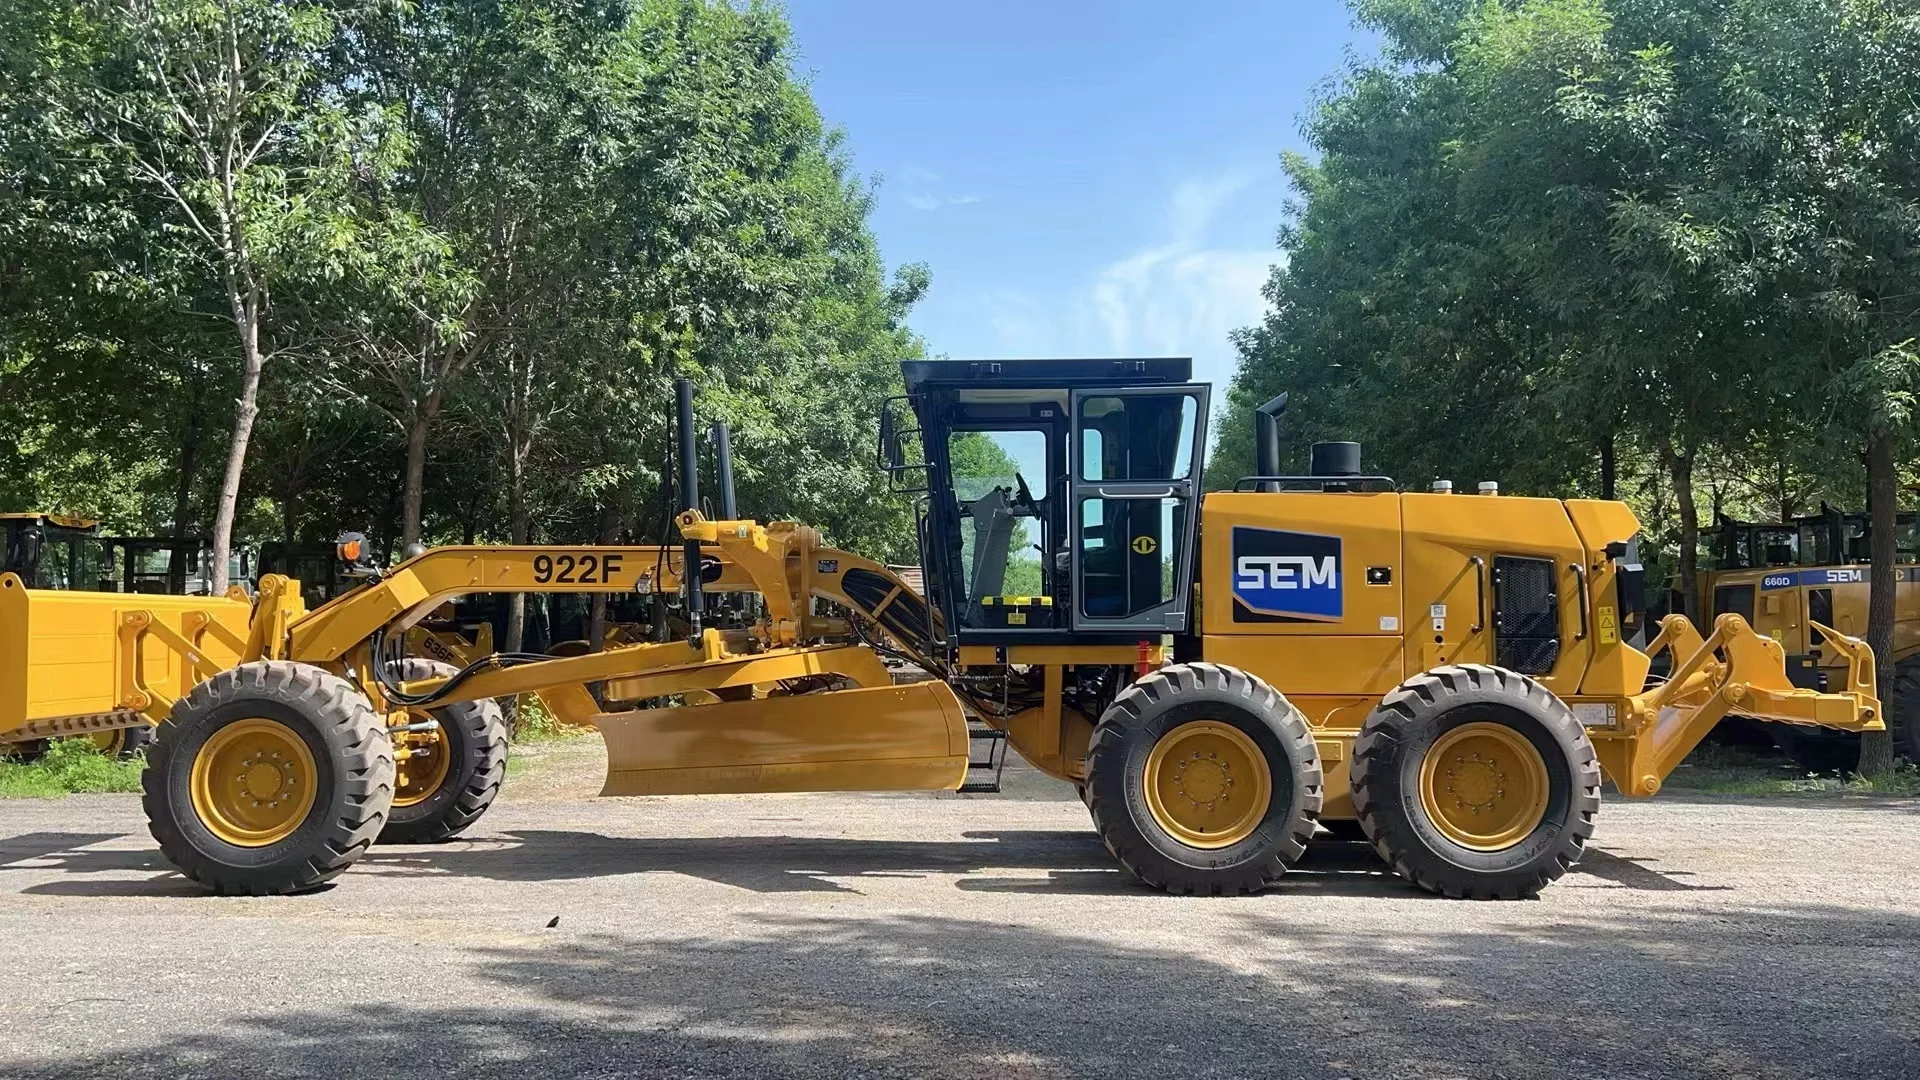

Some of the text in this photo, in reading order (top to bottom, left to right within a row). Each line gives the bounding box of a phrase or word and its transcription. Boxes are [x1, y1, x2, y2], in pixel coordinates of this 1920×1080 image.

[534, 555, 623, 583] 922F
[1238, 556, 1336, 589] SEM
[1826, 569, 1862, 582] SEM
[1765, 577, 1790, 586] 660D
[423, 637, 455, 661] 636F
